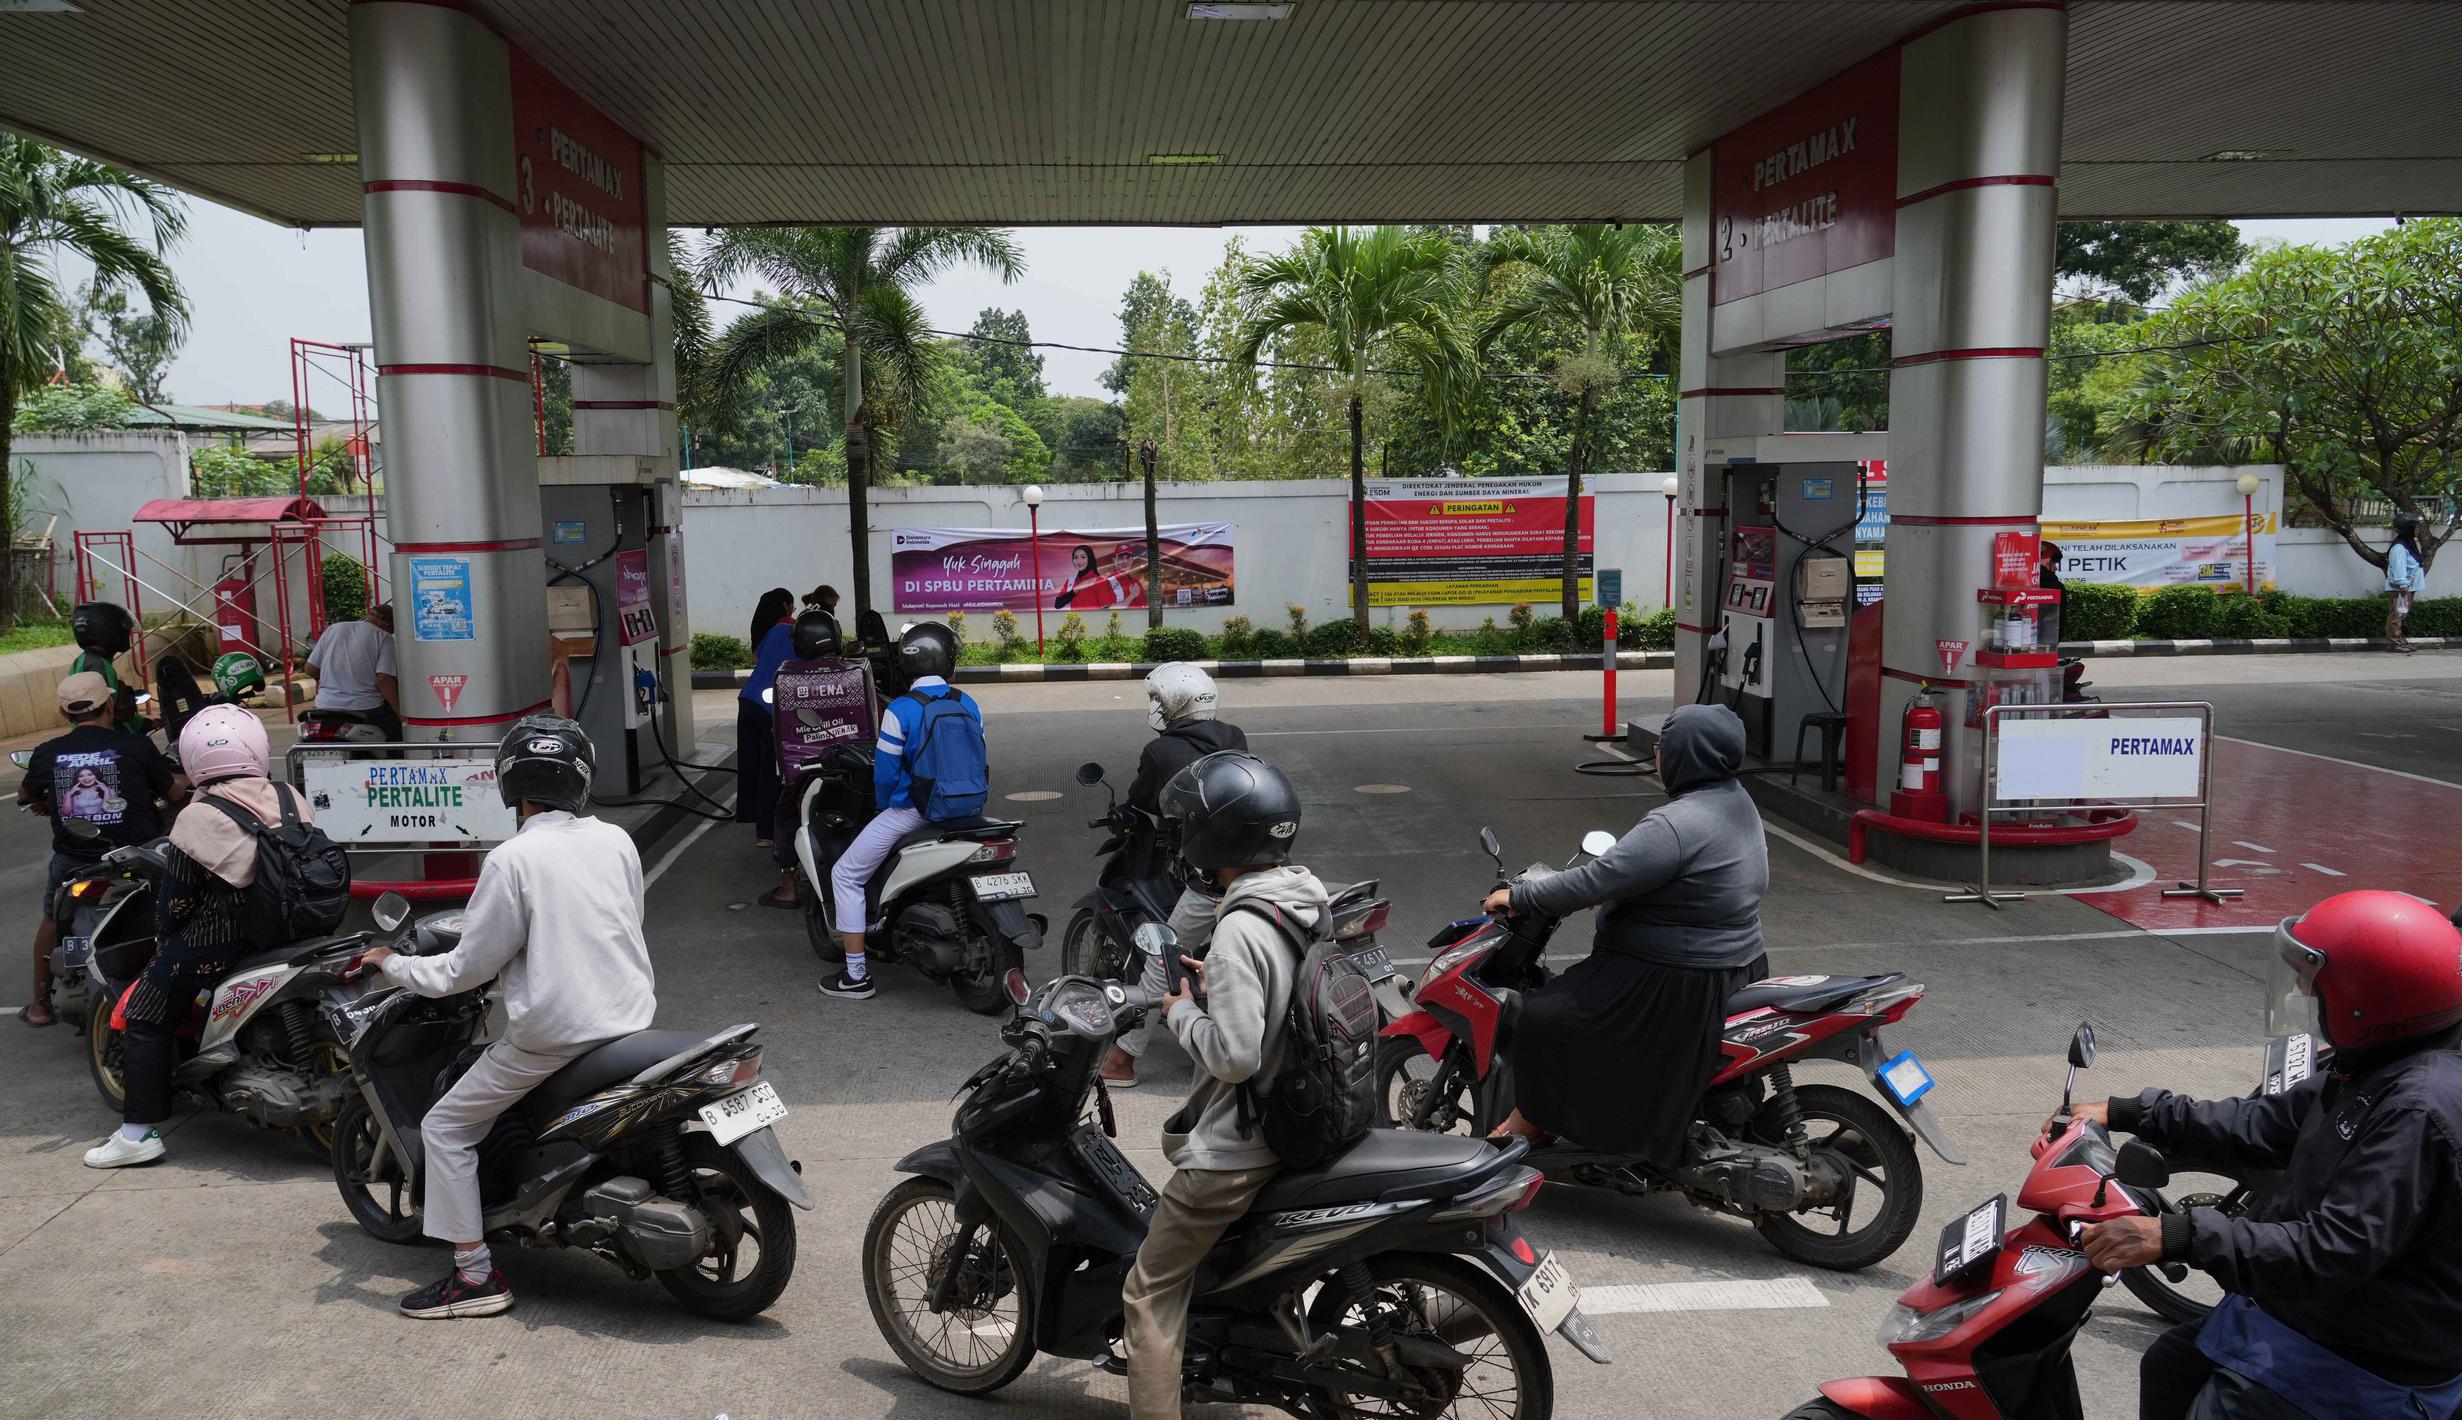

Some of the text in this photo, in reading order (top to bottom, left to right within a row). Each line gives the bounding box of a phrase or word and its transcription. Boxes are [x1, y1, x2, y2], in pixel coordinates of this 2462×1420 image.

[1754, 116, 1856, 191] PERTAMAX
[551, 126, 622, 200] PERTAMAX
[521, 155, 534, 215] 3
[554, 191, 614, 256] PERTALITE
[1753, 191, 1838, 250] PERTALITE
[1721, 215, 1733, 263] 2
[1447, 504, 1500, 512] PERINGATAN
[2104, 543, 2177, 551] DILAKSANAKAN
[943, 553, 1021, 578] Yuk Singgah
[2068, 557, 2127, 572] PETIK
[2200, 564, 2215, 577] 3M
[905, 581, 920, 593] DI
[925, 579, 963, 592] SPBU
[1938, 640, 1964, 649] APAR
[433, 675, 462, 684] APAR
[796, 725, 811, 734] Mie
[832, 718, 845, 727] Oil
[2111, 738, 2194, 755] PERTAMAX
[56, 752, 101, 763] DEDE
[68, 757, 115, 768] APRIL
[368, 786, 463, 808] PERTALITE
[390, 815, 436, 828] MOTOR
[67, 940, 74, 952] B
[704, 1110, 718, 1126] B
[1524, 1258, 1562, 1309] K 6917
[1922, 1380, 1976, 1392] HONDA
